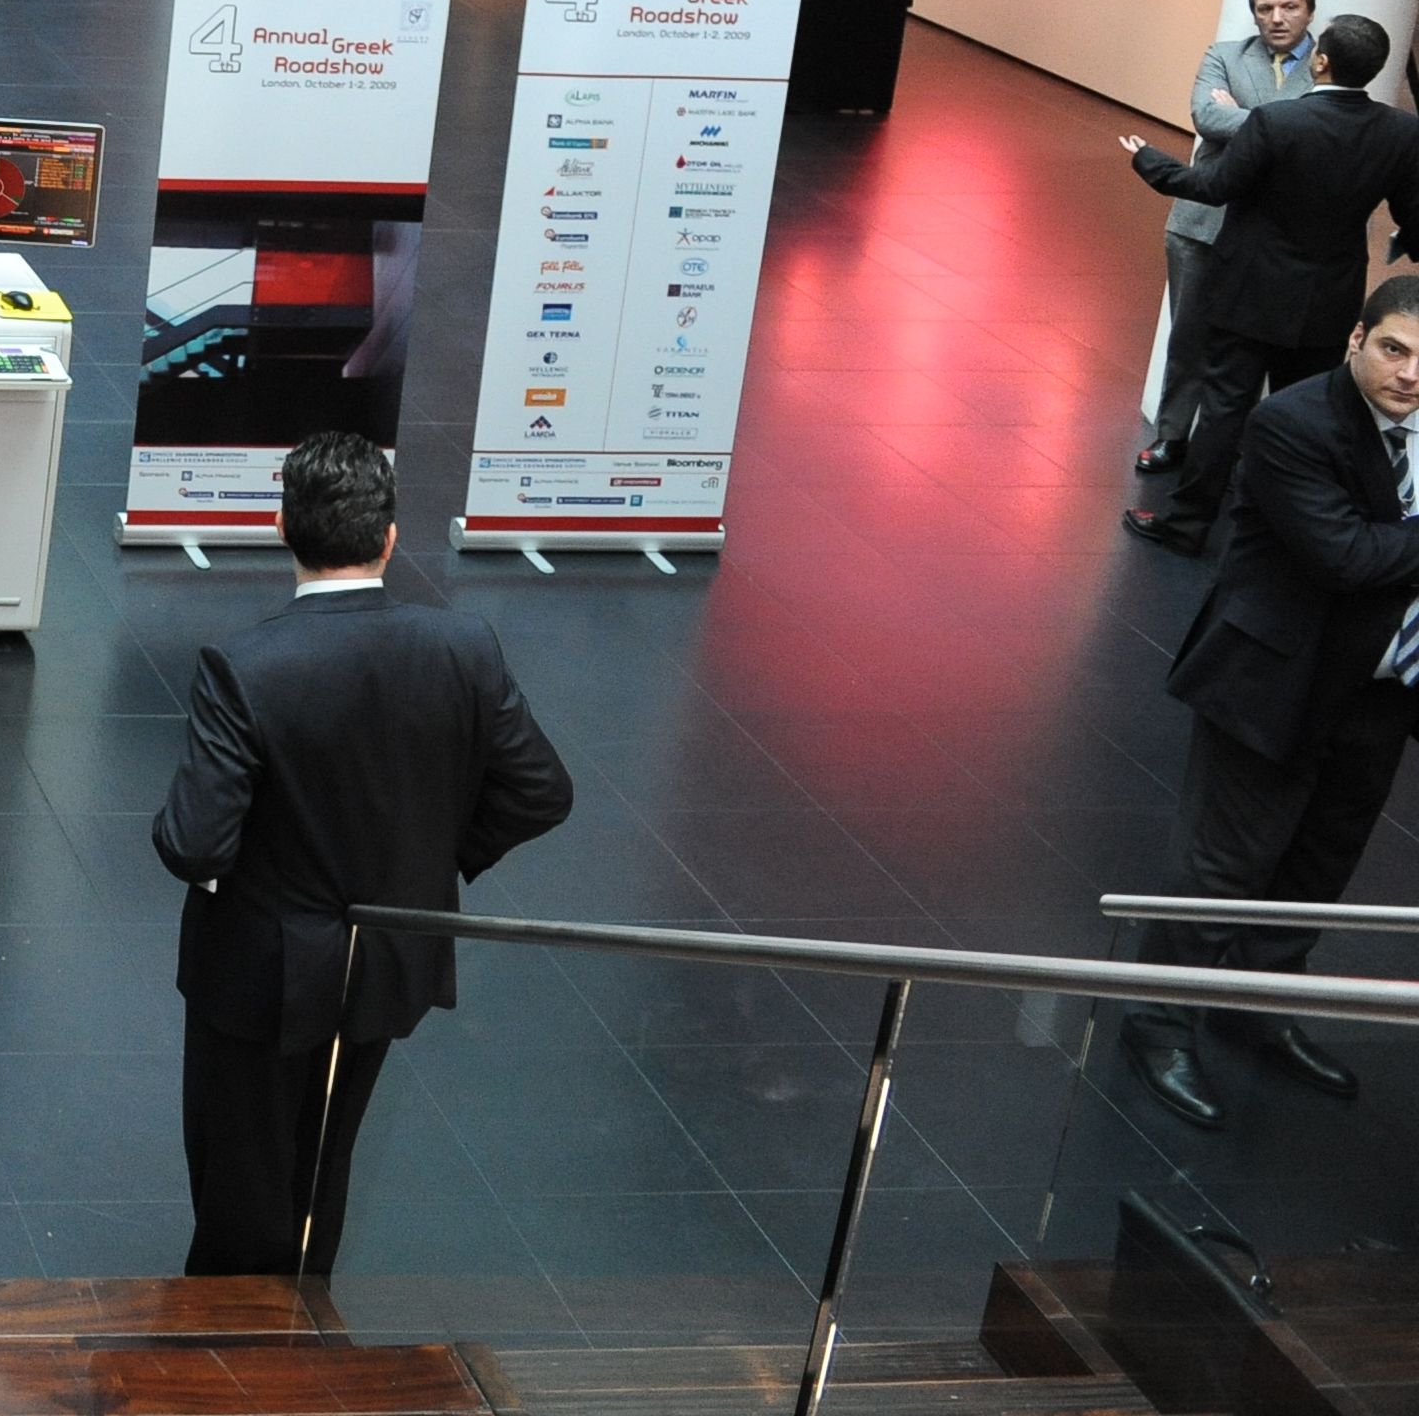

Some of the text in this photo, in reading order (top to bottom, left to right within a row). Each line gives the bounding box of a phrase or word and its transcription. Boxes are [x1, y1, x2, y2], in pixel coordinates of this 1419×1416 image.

[629, 6, 739, 25] Roadshow
[616, 29, 655, 39] London,
[659, 29, 700, 39] October
[724, 31, 751, 40] 2009
[253, 27, 329, 45] Annual
[331, 37, 393, 56] Greek
[274, 56, 384, 75] Roadshow
[261, 80, 301, 89] London,
[304, 80, 346, 89] October
[369, 81, 397, 90] 2009
[688, 90, 737, 100] MARFIN
[666, 458, 723, 471] Bloomberg
